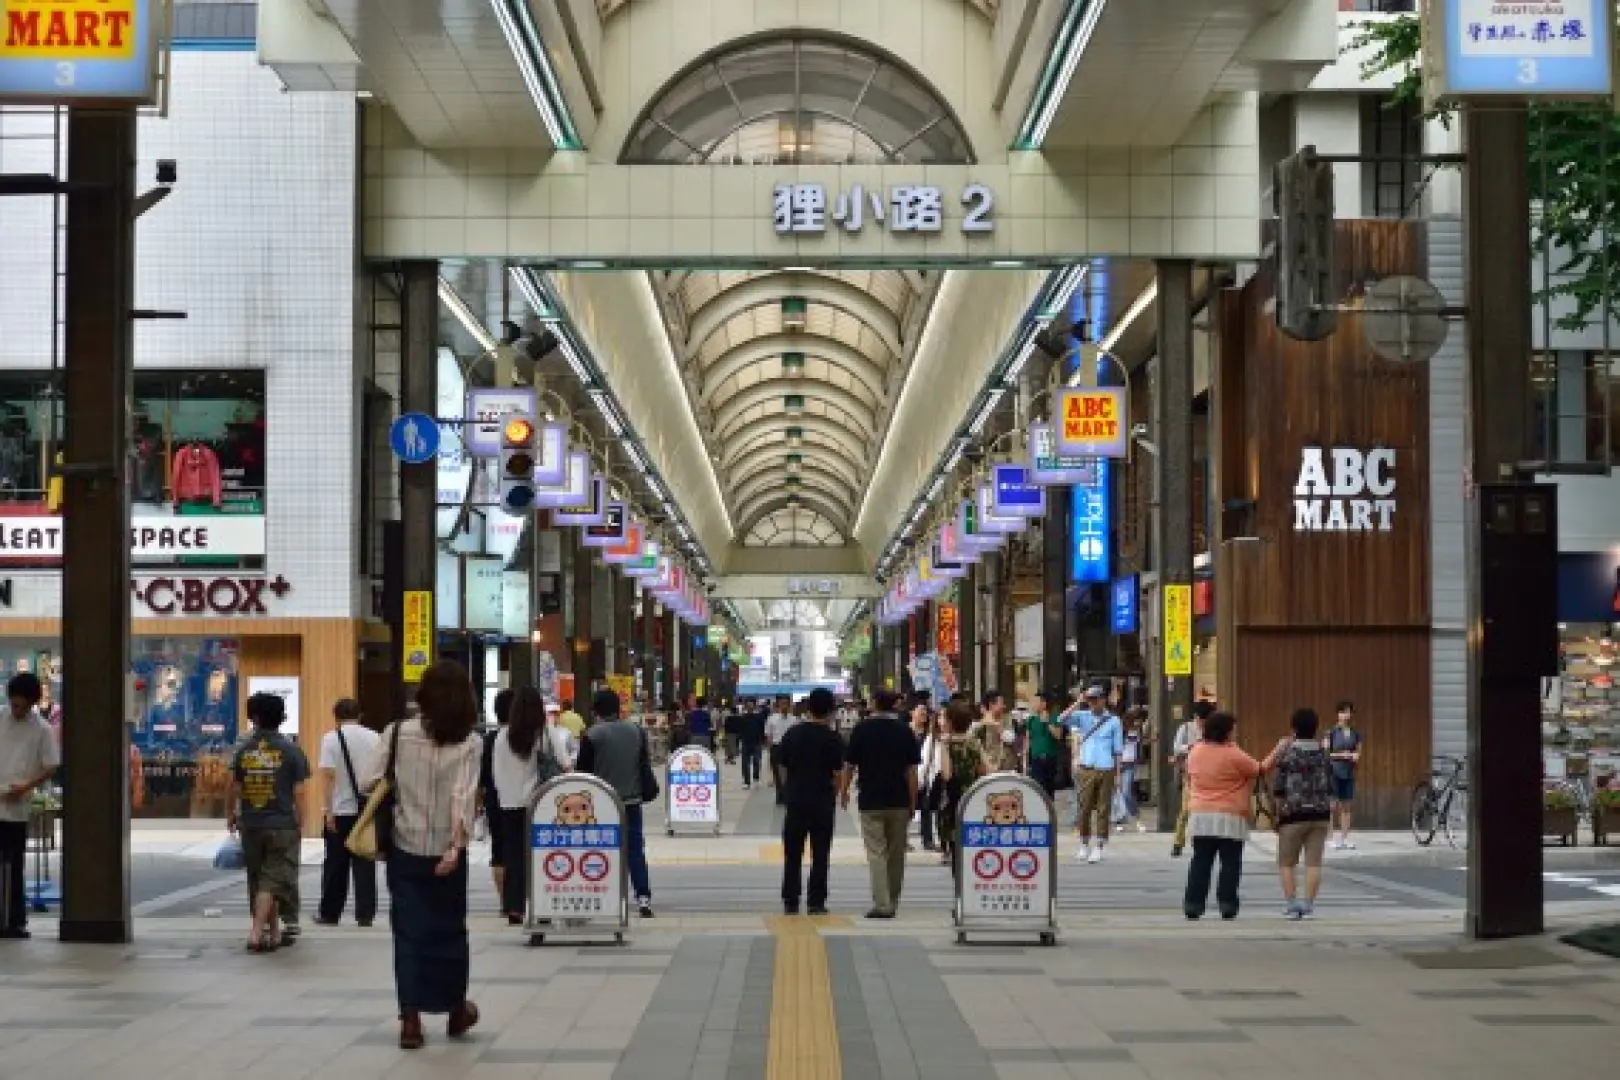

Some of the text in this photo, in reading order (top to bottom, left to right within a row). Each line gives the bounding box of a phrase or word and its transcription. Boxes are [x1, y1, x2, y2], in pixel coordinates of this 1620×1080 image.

[5, 11, 130, 47] MART
[54, 62, 75, 86] 3
[1517, 60, 1538, 84] 3
[773, 183, 994, 234] 狸小路 2
[1067, 397, 1111, 418] ABC
[1065, 420, 1117, 438] MART
[1294, 447, 1396, 496] ABC
[1293, 499, 1396, 532] MART
